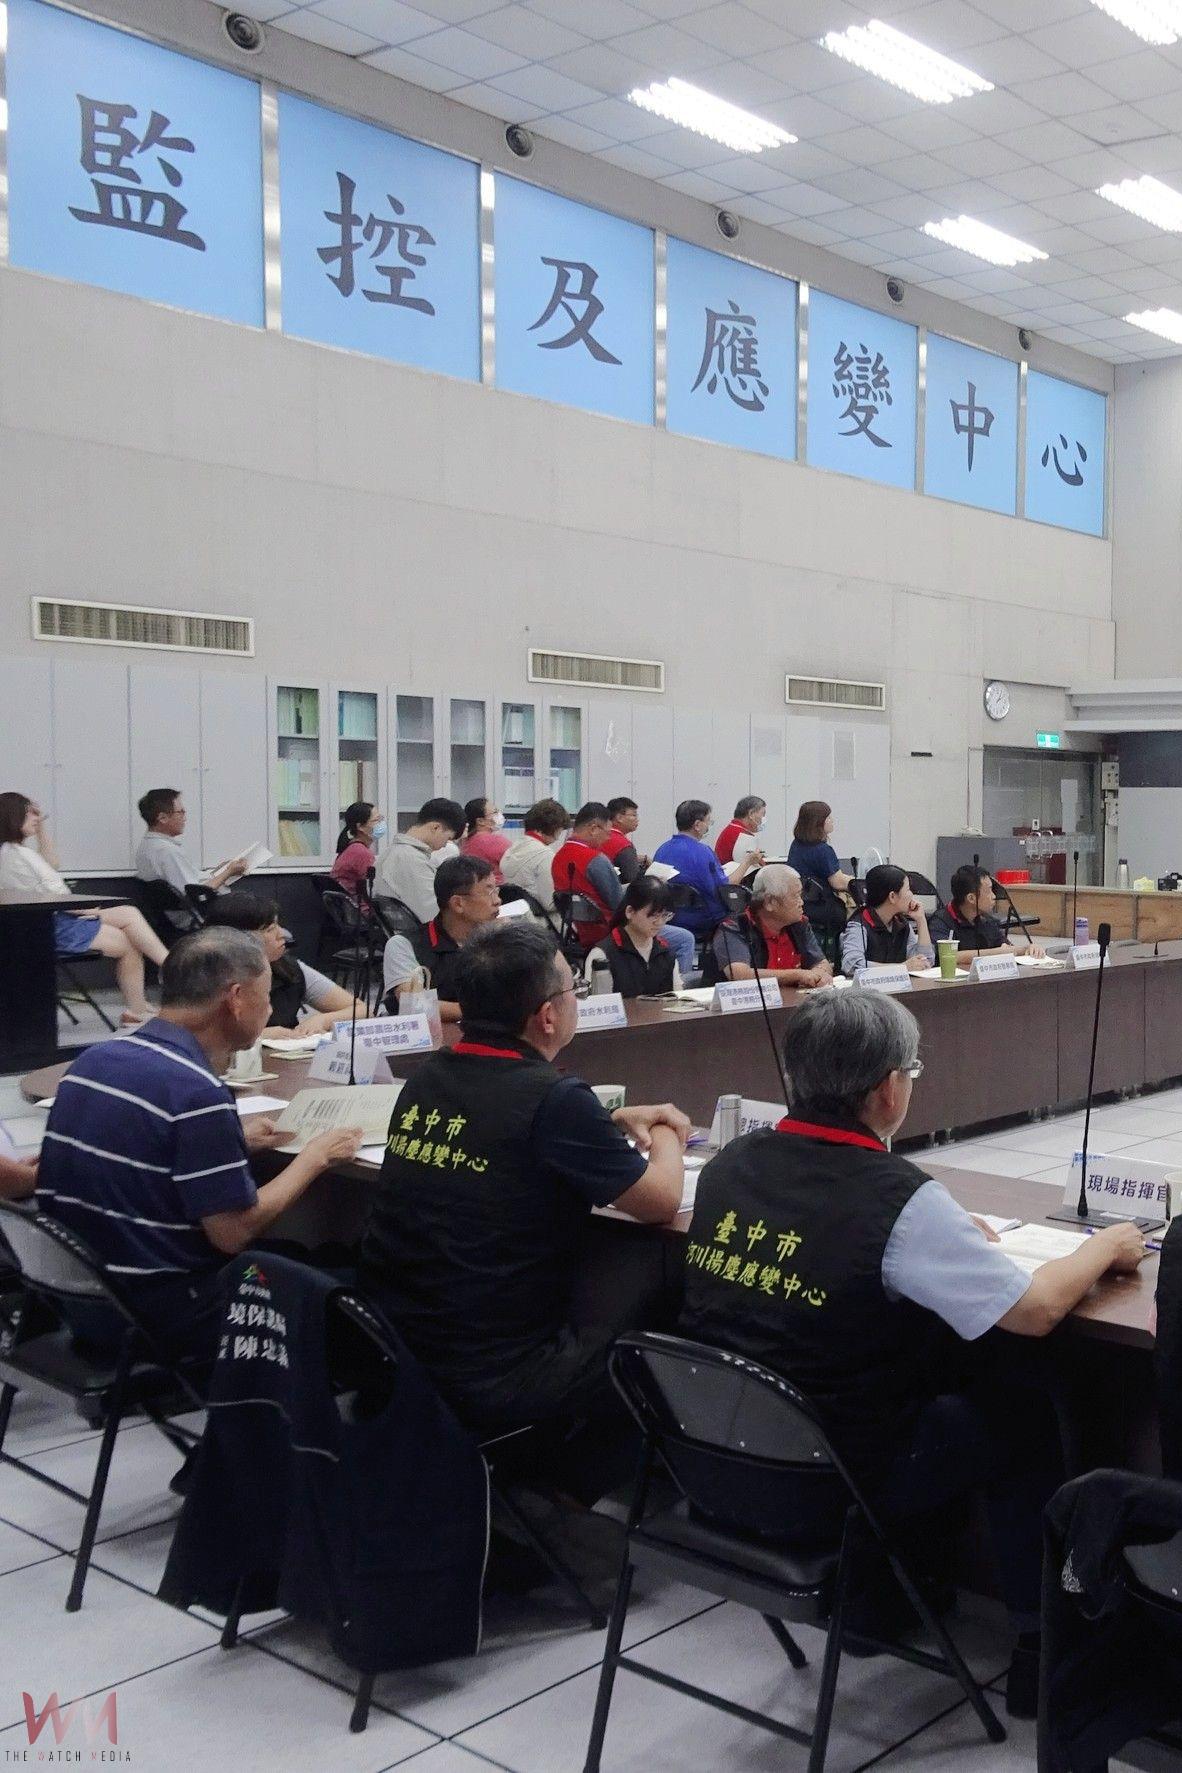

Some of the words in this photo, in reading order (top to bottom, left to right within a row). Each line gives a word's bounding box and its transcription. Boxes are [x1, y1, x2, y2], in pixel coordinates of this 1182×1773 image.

[67, 93, 1088, 488] 監控及應變中心
[400, 1103, 467, 1142] 臺中市
[1086, 1174, 1170, 1202] 現場指揮官
[713, 1210, 802, 1263] 臺中市
